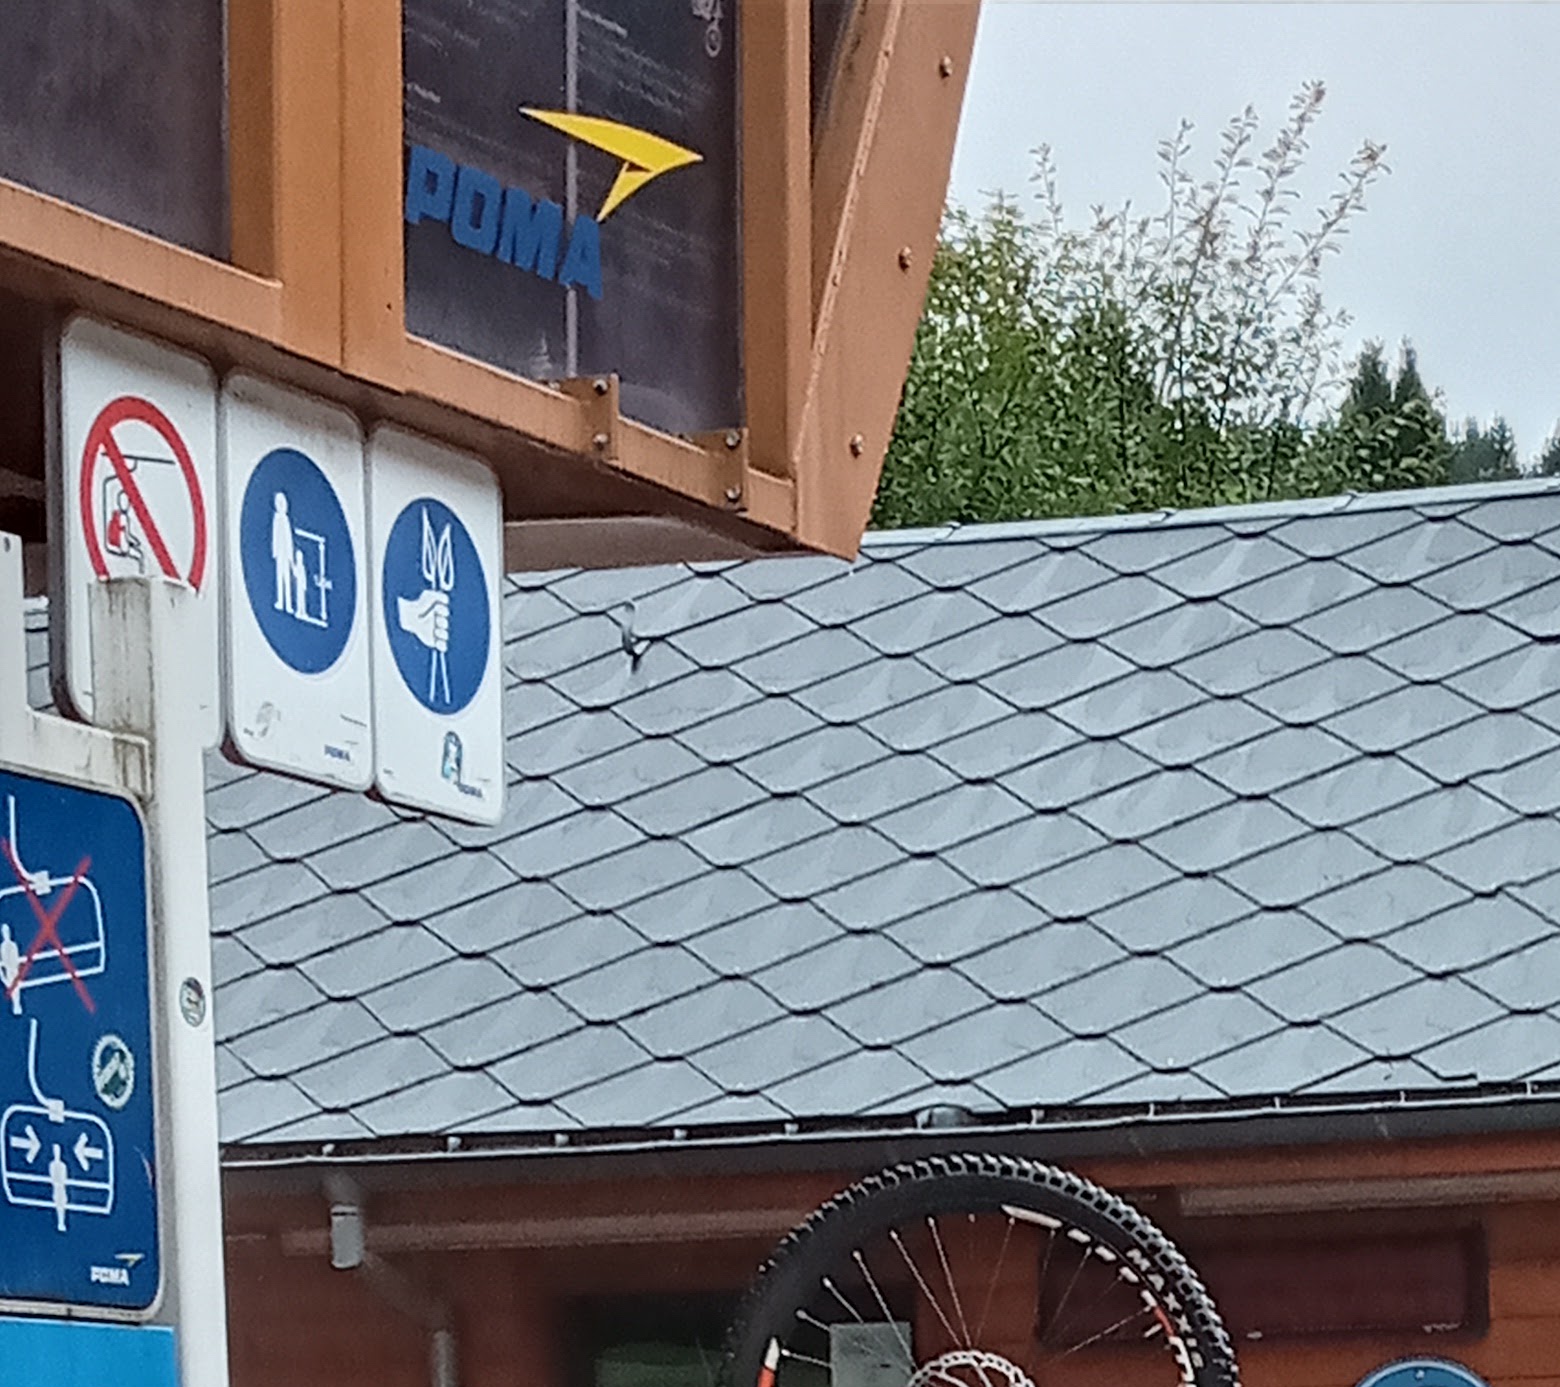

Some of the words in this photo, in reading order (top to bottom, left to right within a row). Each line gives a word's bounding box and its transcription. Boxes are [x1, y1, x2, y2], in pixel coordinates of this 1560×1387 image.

[405, 144, 604, 300] POMA
[90, 1265, 131, 1288] POMA
[1125, 1248, 1205, 1368] MAXXIS
